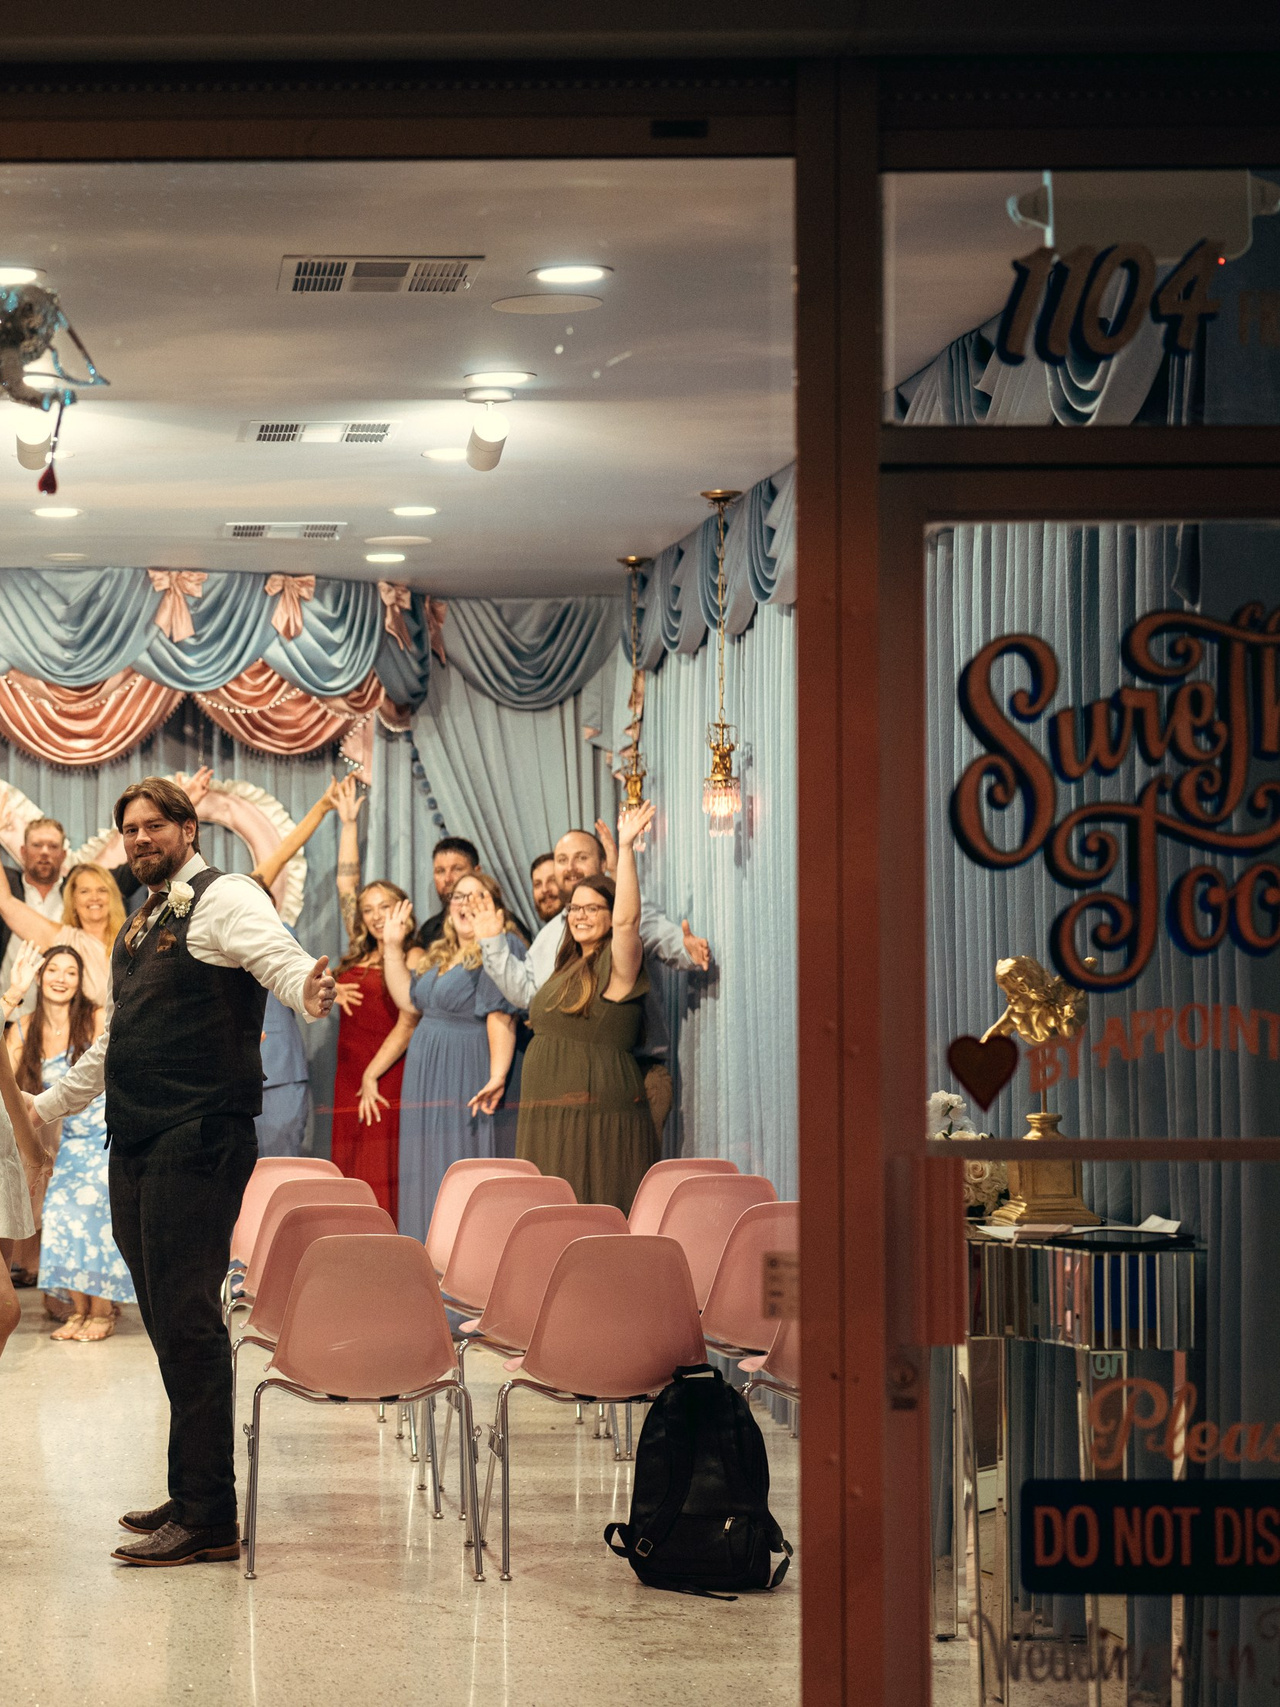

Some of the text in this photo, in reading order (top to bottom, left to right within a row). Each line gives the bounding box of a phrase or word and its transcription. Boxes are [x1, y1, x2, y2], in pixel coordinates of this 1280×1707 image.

[996, 237, 1226, 366] 1104
[949, 632, 1229, 871] Sure
[1024, 1003, 1280, 1094] BY APPOINT
[1033, 1504, 1280, 1568] DO NOT DIS
